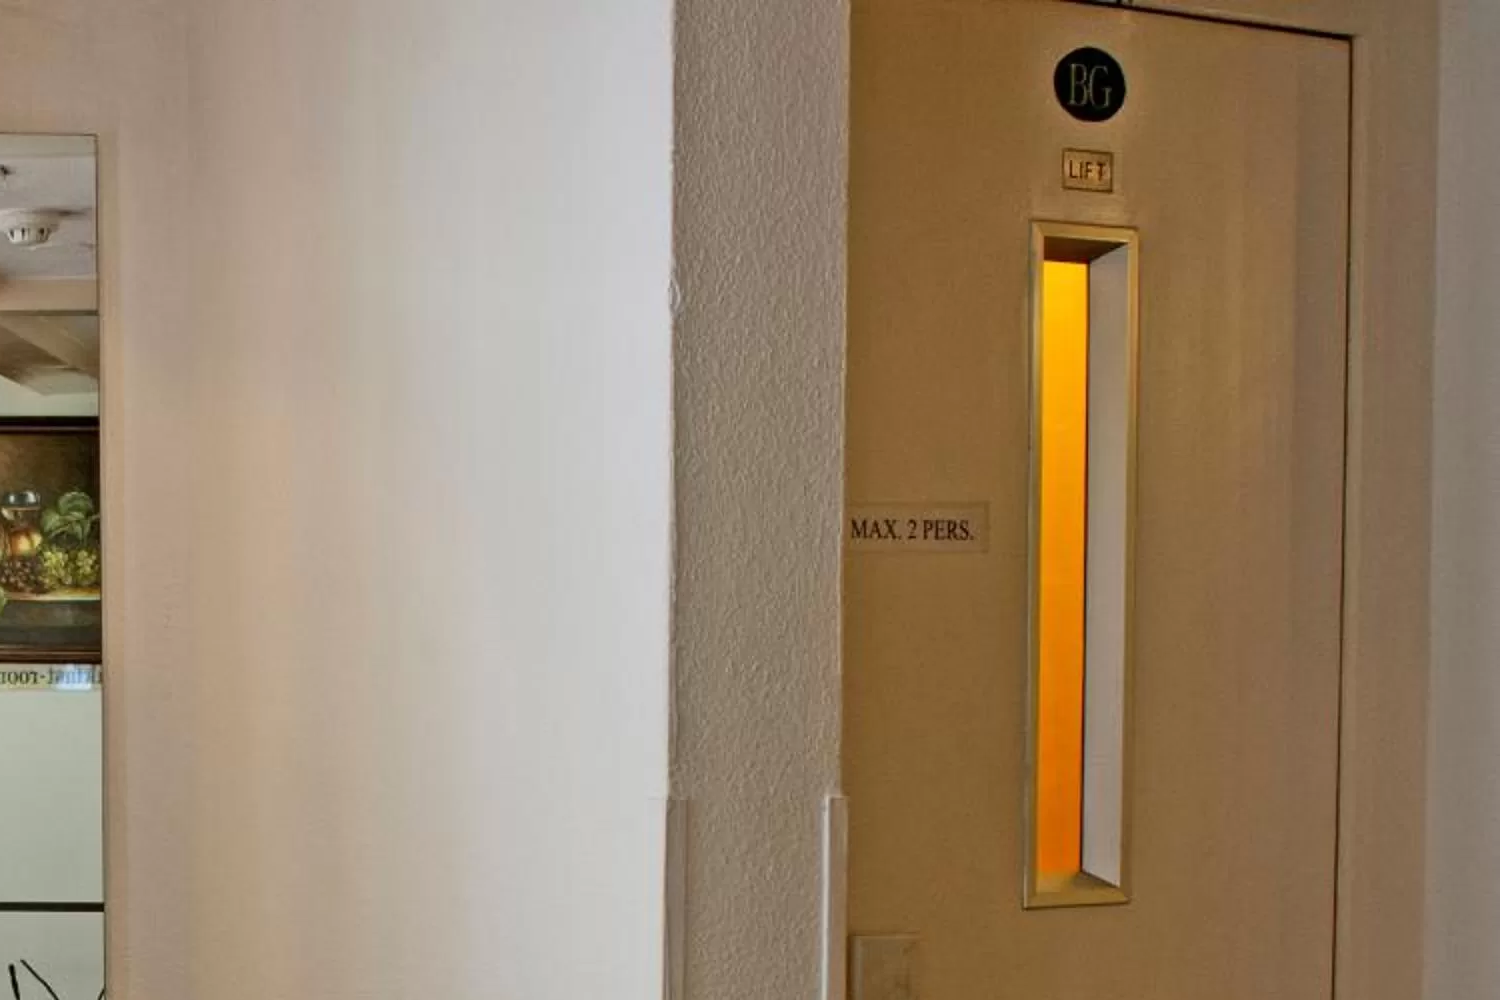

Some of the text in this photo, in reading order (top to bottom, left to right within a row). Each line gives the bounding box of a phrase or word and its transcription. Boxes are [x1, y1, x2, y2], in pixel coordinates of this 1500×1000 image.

[1068, 62, 1113, 109] BG
[1068, 160, 1107, 181] LIFT
[850, 517, 975, 542] MAX. 2 PERS.
